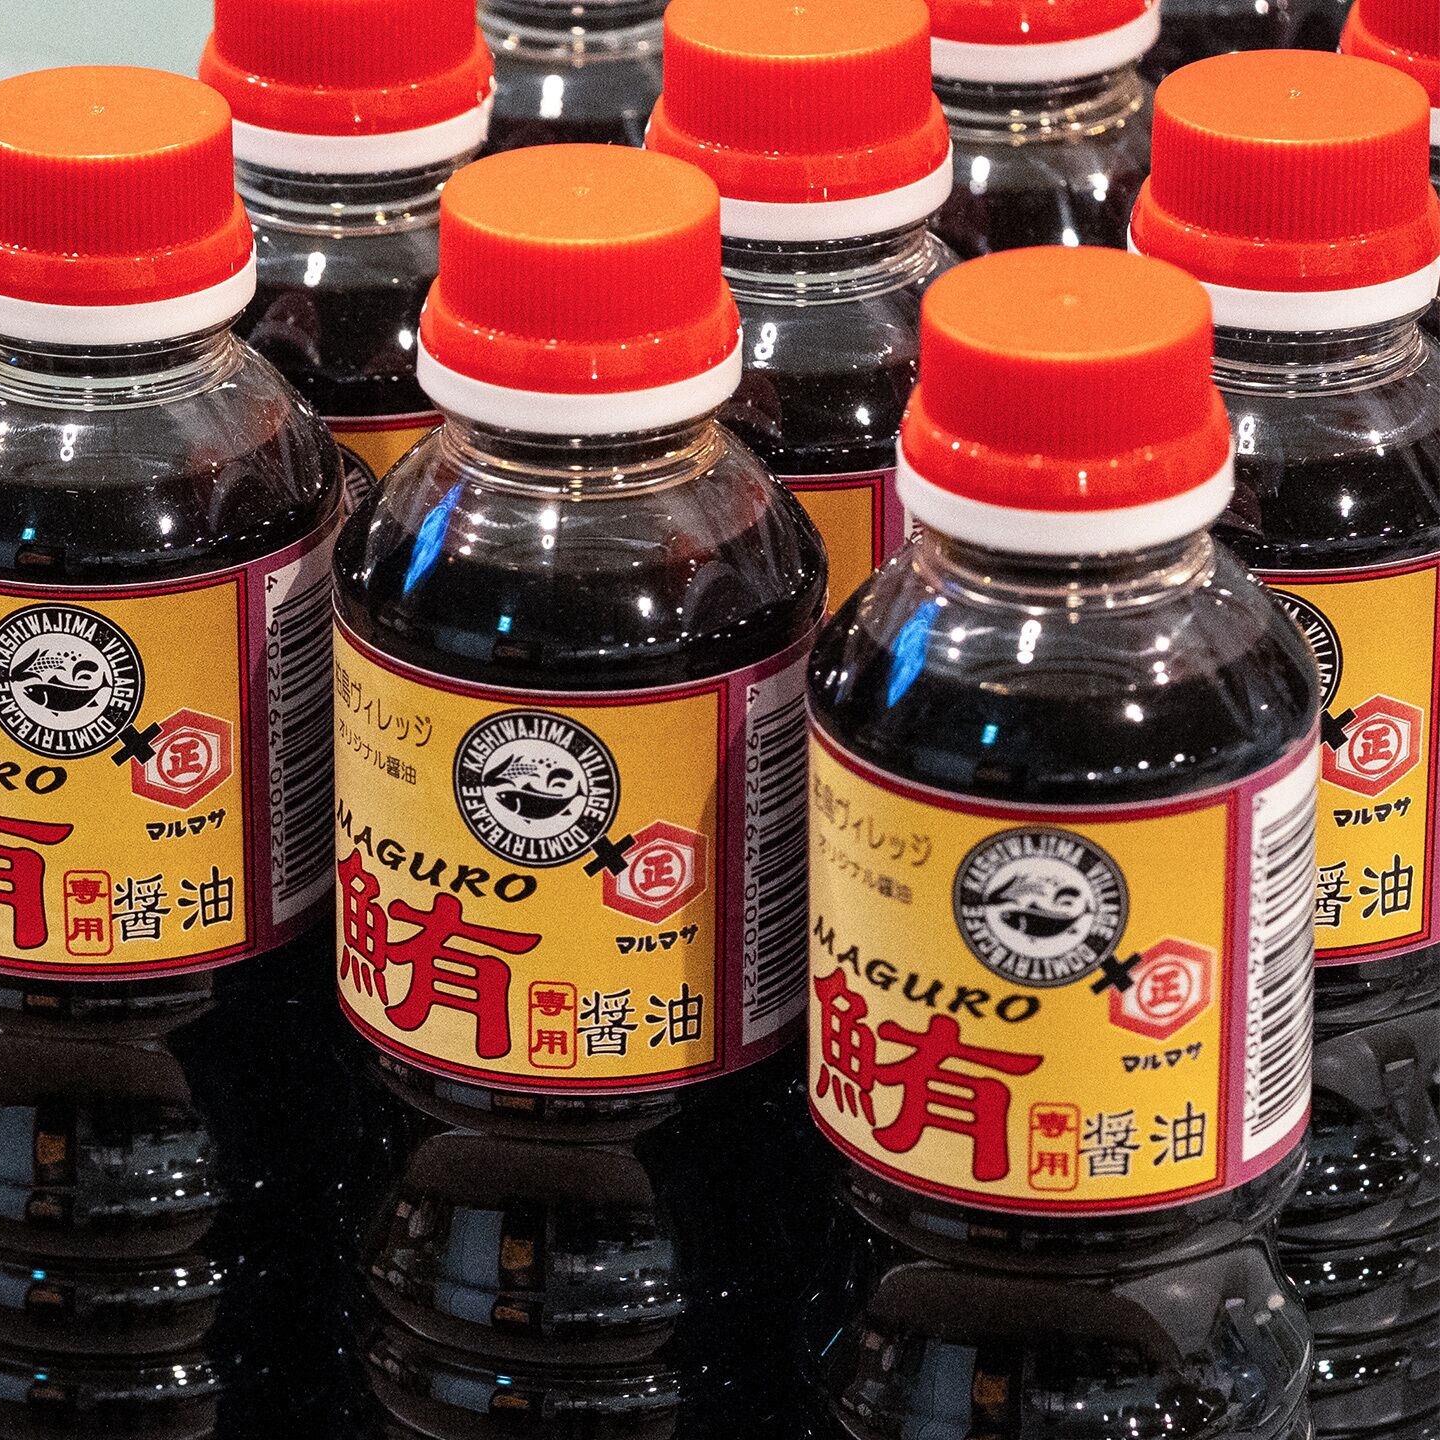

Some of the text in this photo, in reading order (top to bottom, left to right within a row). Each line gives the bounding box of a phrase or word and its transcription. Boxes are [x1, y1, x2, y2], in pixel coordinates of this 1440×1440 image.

[101, 637, 135, 712] VILLAGE
[462, 717, 575, 774] KASHIWAJIMA
[577, 745, 611, 822] VILLAGE
[146, 809, 226, 841] マルマサ
[1333, 796, 1412, 828] マルマサ
[336, 798, 538, 903] MAGURO
[68, 878, 108, 943] 専用
[112, 866, 235, 942] 醤油
[616, 922, 699, 955] マルマサ
[337, 847, 543, 1060] 鮪
[812, 916, 1042, 1024] MAGURO
[532, 989, 573, 1056] 専用
[577, 982, 704, 1057] 醤油
[813, 966, 1044, 1183] 鮪
[1079, 1101, 1208, 1179] 醤油
